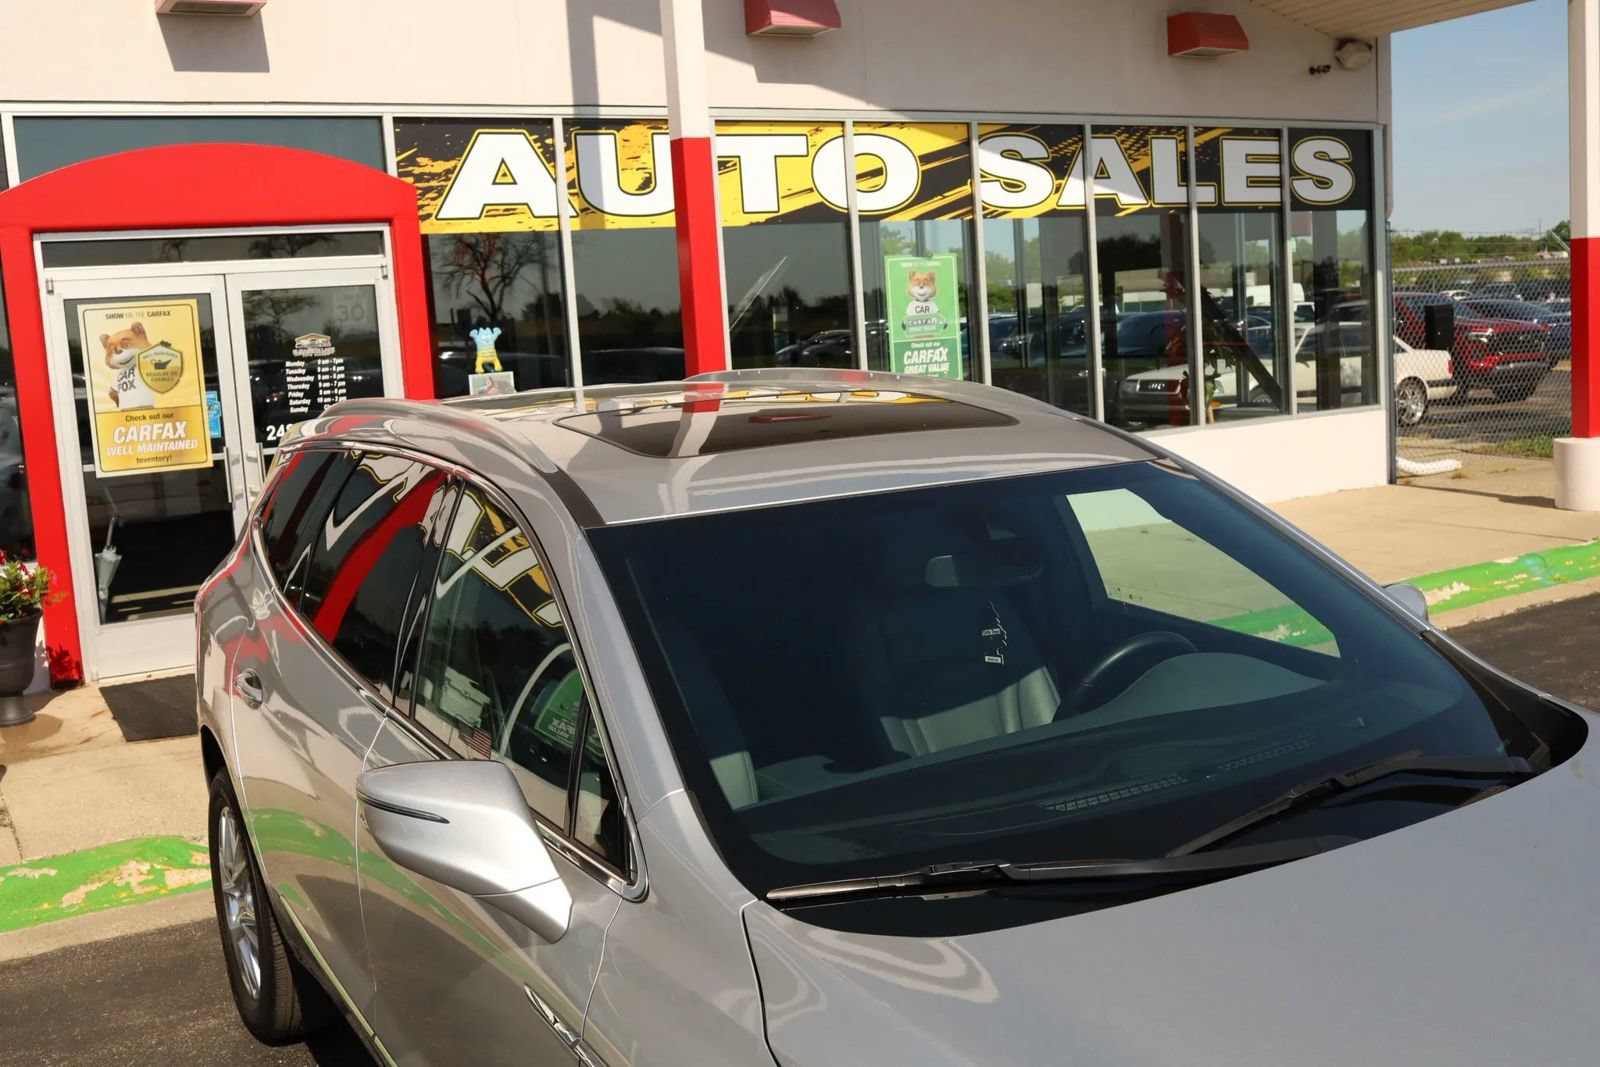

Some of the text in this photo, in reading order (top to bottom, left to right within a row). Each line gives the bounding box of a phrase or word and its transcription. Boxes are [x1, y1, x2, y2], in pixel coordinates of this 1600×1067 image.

[434, 131, 1355, 220] AUTO SALES
[915, 305, 930, 313] CAR
[146, 310, 171, 318] CARFAX
[903, 346, 949, 365] CARFAX
[285, 360, 305, 368] Monday
[928, 362, 951, 372] VALUE
[289, 398, 311, 406] Saturday
[290, 406, 309, 414] Sunday
[125, 414, 147, 422] Check
[113, 420, 187, 444] CARFAX
[266, 423, 294, 441] 24
[106, 439, 198, 457] WELL MAINTAINED
